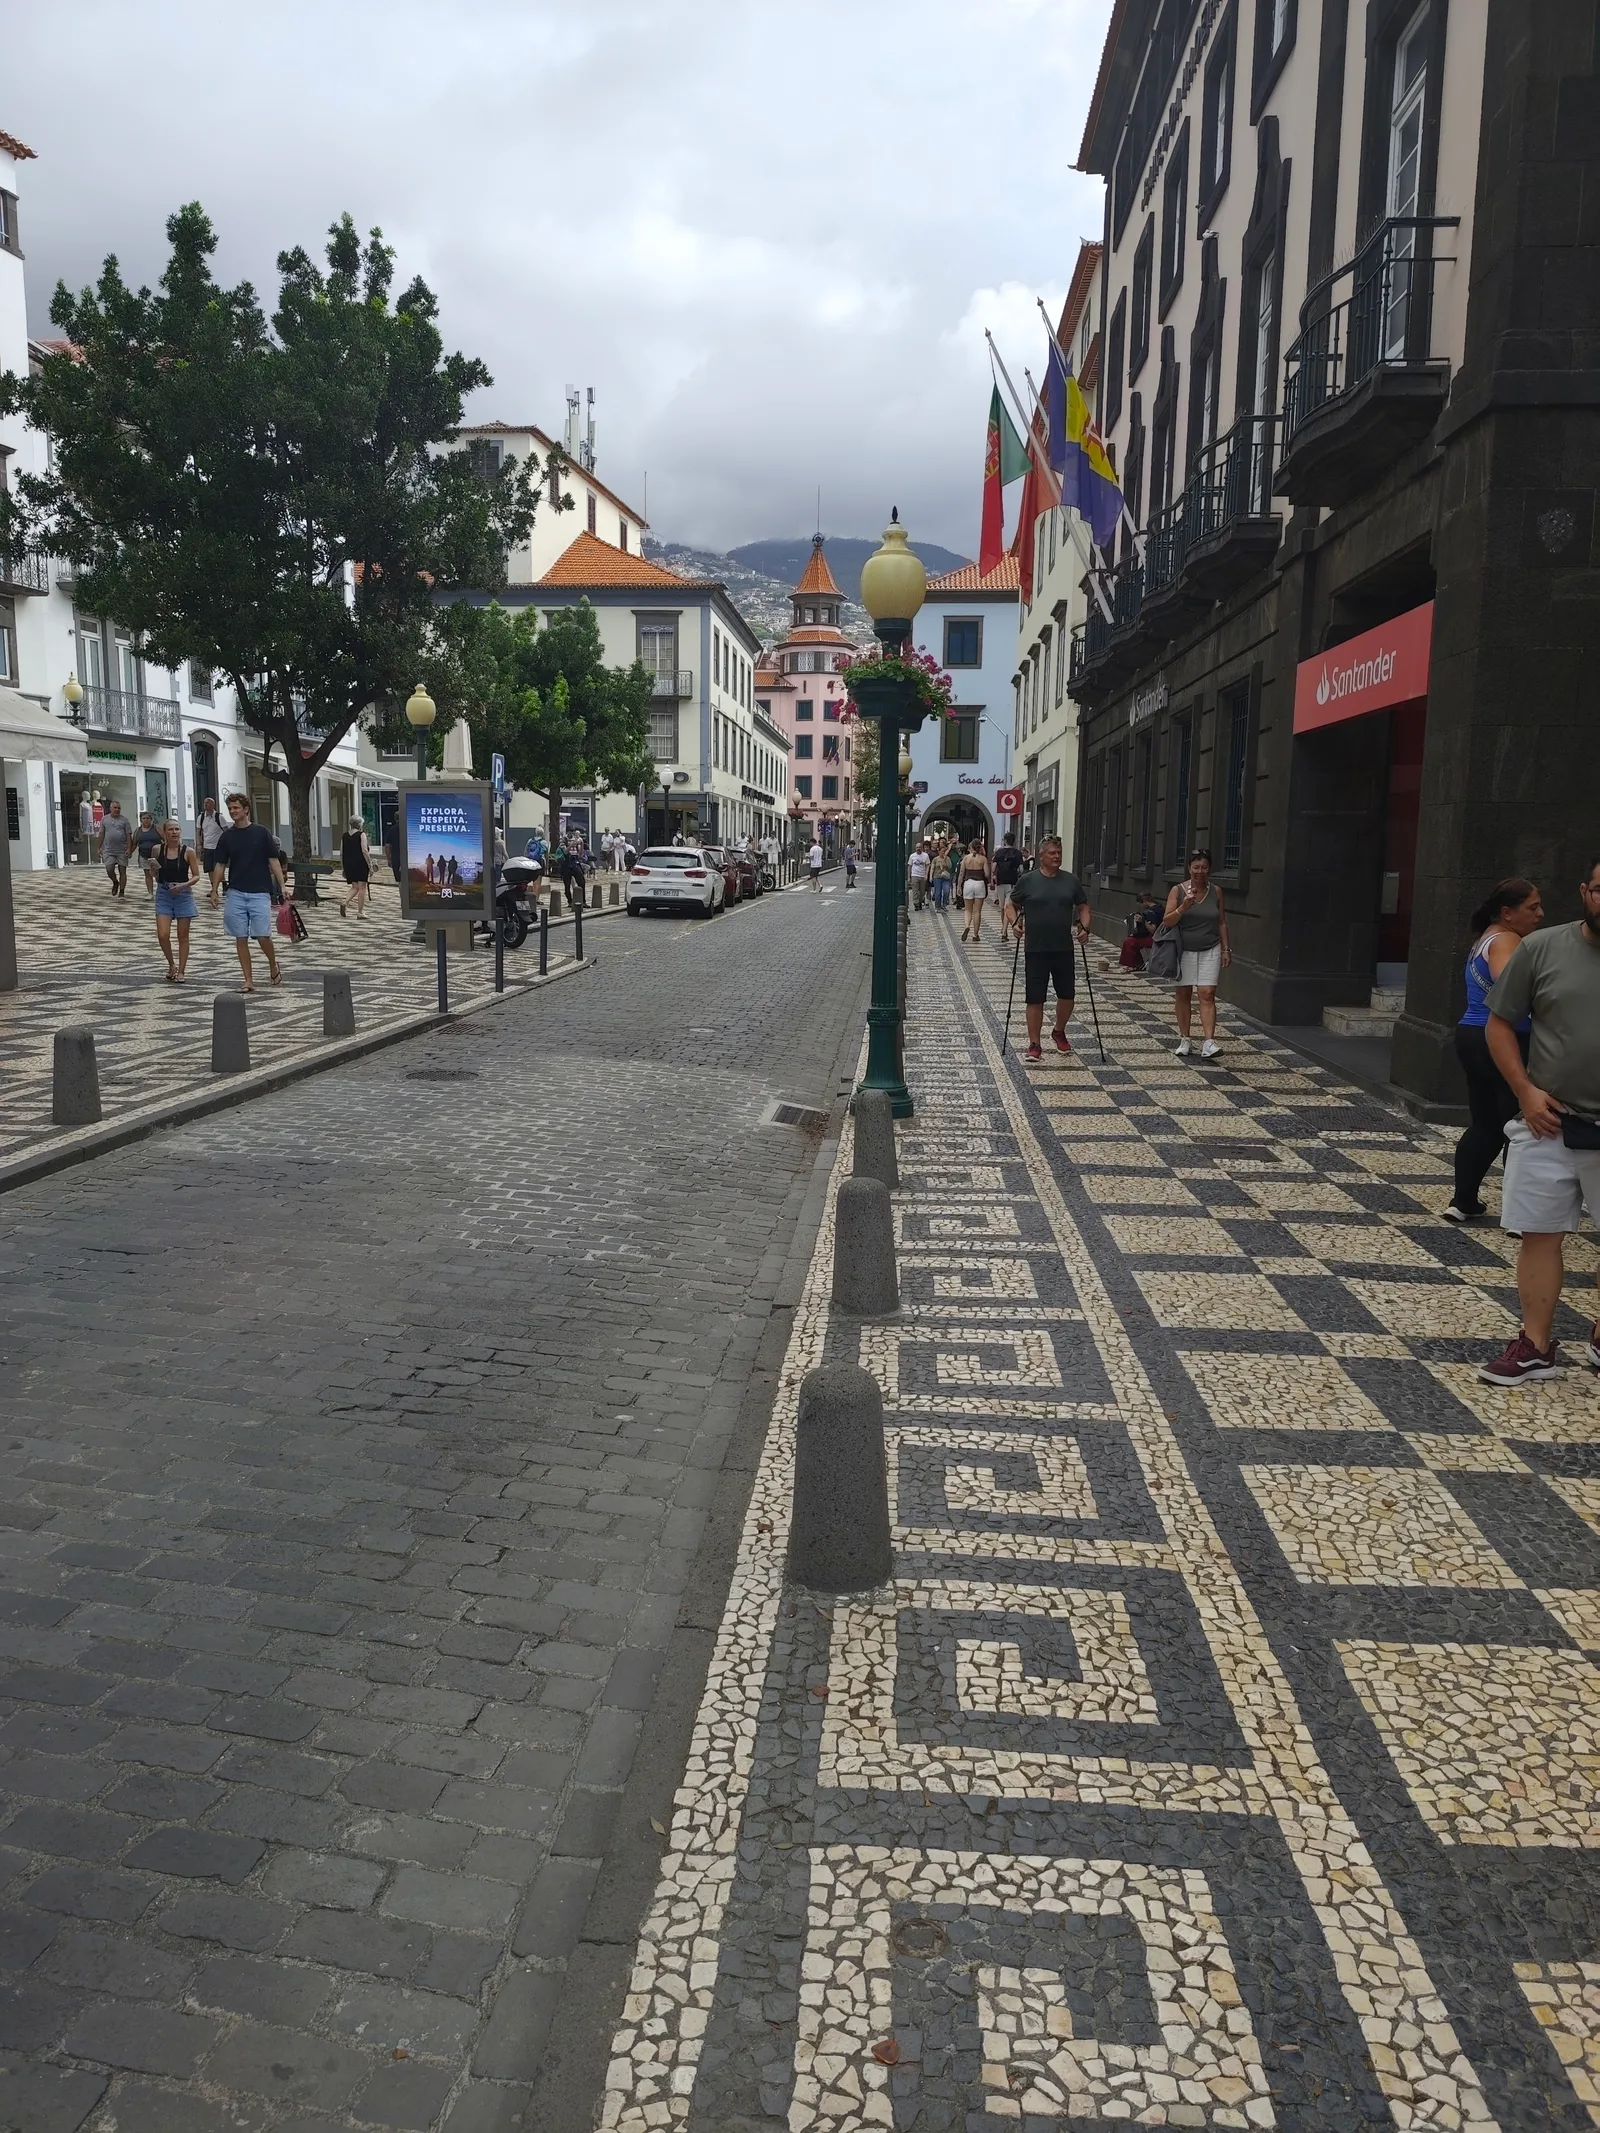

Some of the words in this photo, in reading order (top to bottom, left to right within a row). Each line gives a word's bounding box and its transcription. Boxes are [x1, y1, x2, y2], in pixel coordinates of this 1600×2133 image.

[1331, 648, 1397, 701] Santander
[495, 758, 503, 789] P
[958, 772, 984, 785] Casa
[421, 807, 467, 816] EXPLORA.
[420, 816, 468, 824] RESPEITA.
